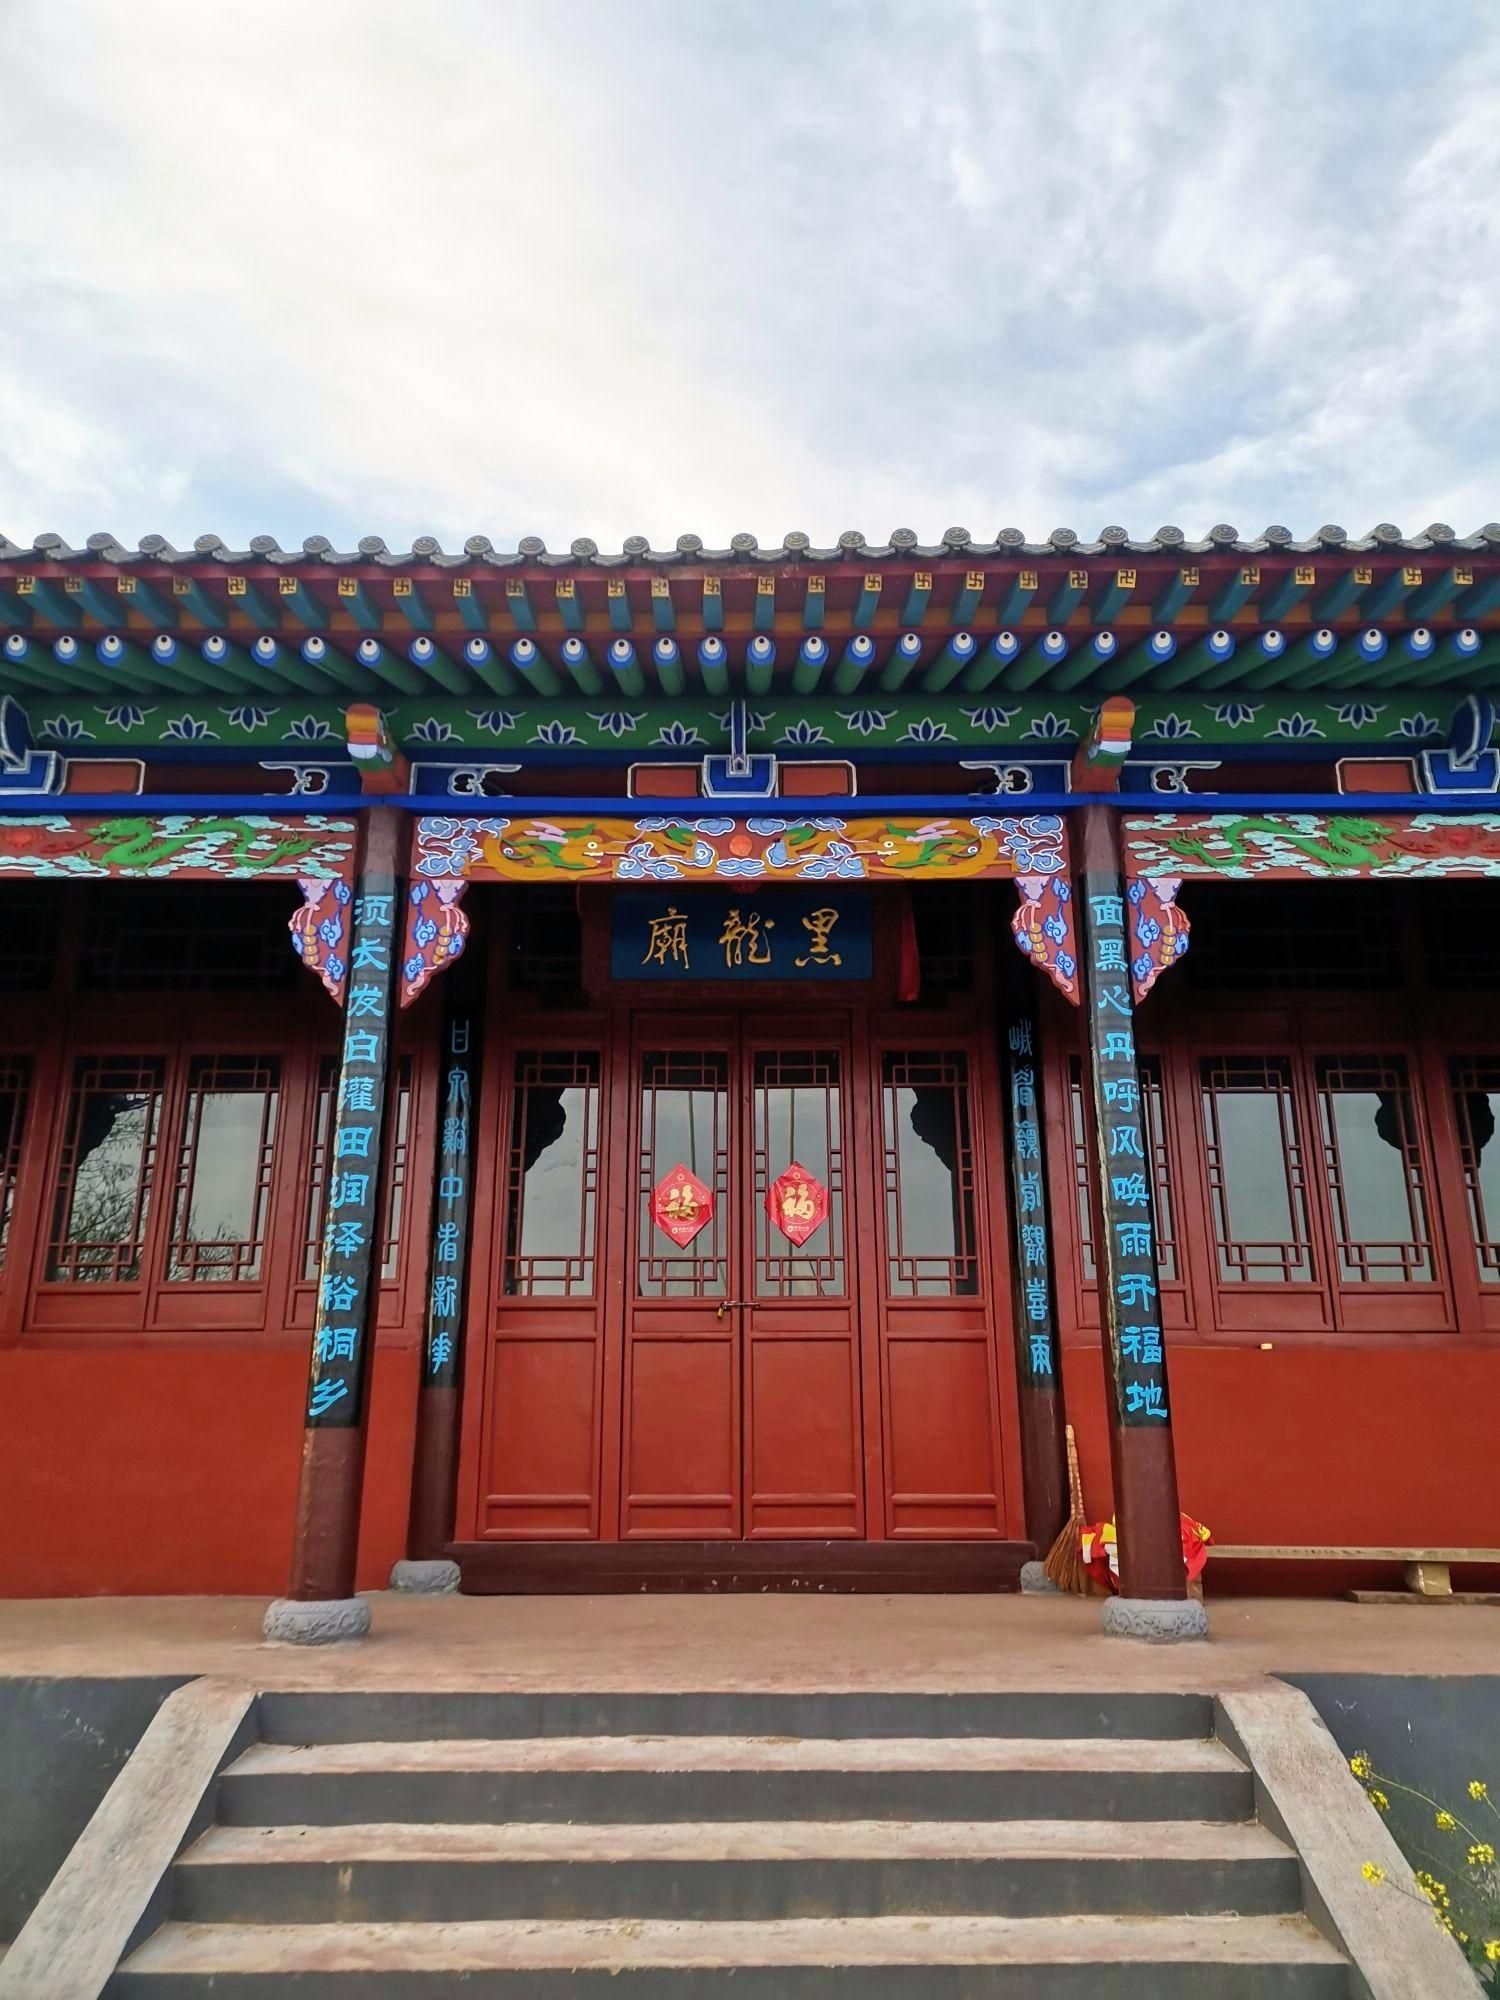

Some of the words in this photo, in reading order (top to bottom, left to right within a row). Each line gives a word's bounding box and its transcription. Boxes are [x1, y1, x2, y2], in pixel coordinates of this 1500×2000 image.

[1088, 895, 1168, 1418] 面黑心丹呼风唤雨开福地
[665, 1184, 698, 1221] 福
[782, 1183, 814, 1220] 福
